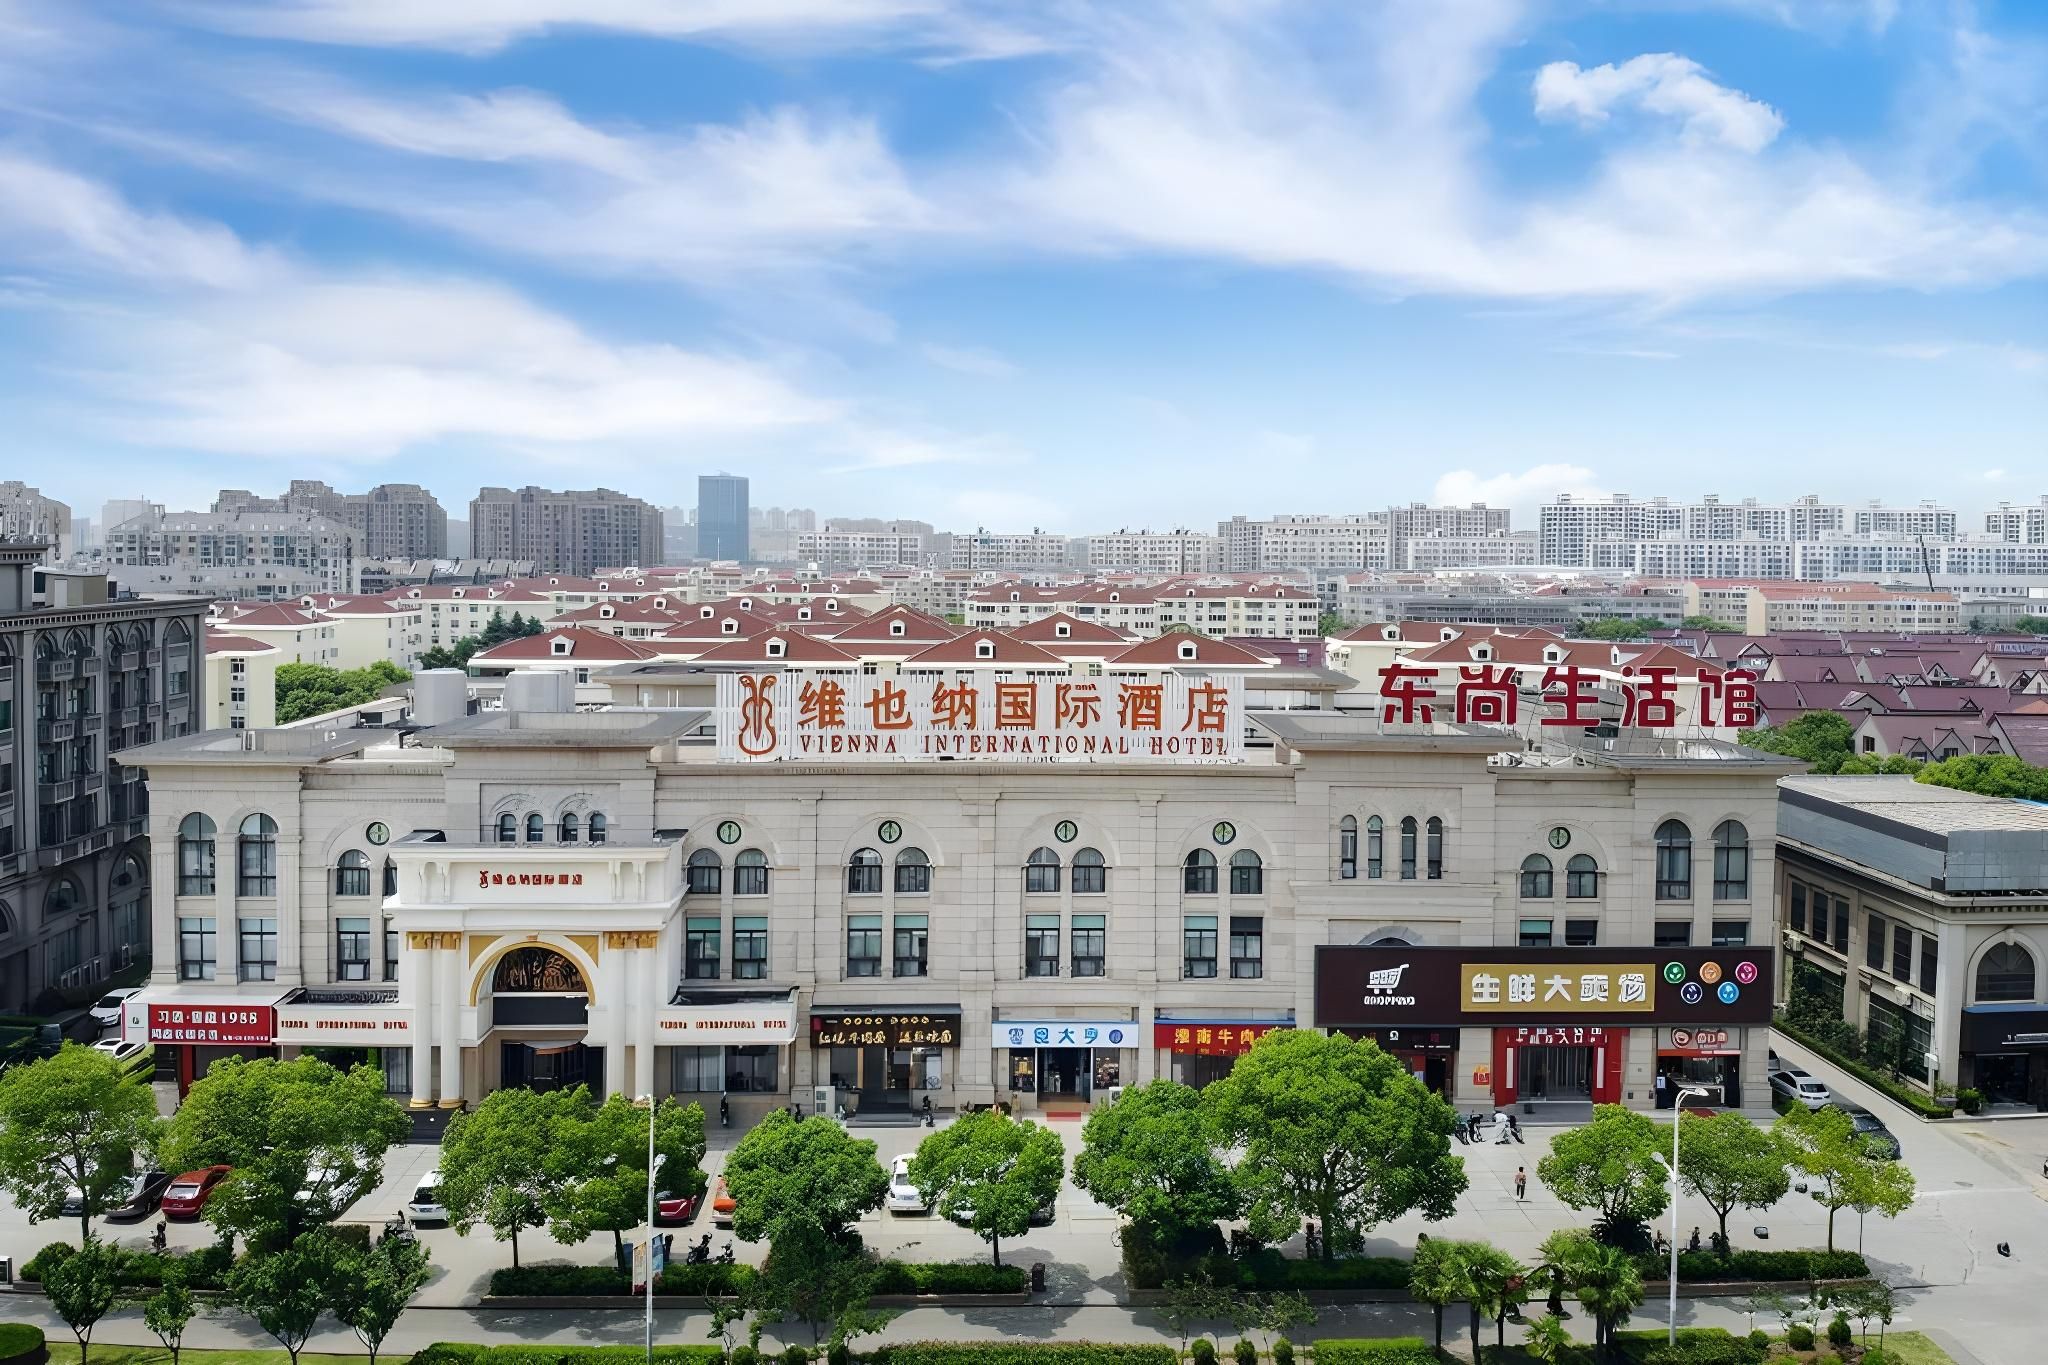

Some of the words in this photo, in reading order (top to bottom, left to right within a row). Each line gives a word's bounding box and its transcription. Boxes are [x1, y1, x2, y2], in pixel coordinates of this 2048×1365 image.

[798, 680, 1228, 733] 维也纳国际酒店
[1378, 664, 1757, 728] 东尚生活馆
[800, 735, 897, 754] VIENNA
[923, 735, 1129, 754] INTERNATIONAL
